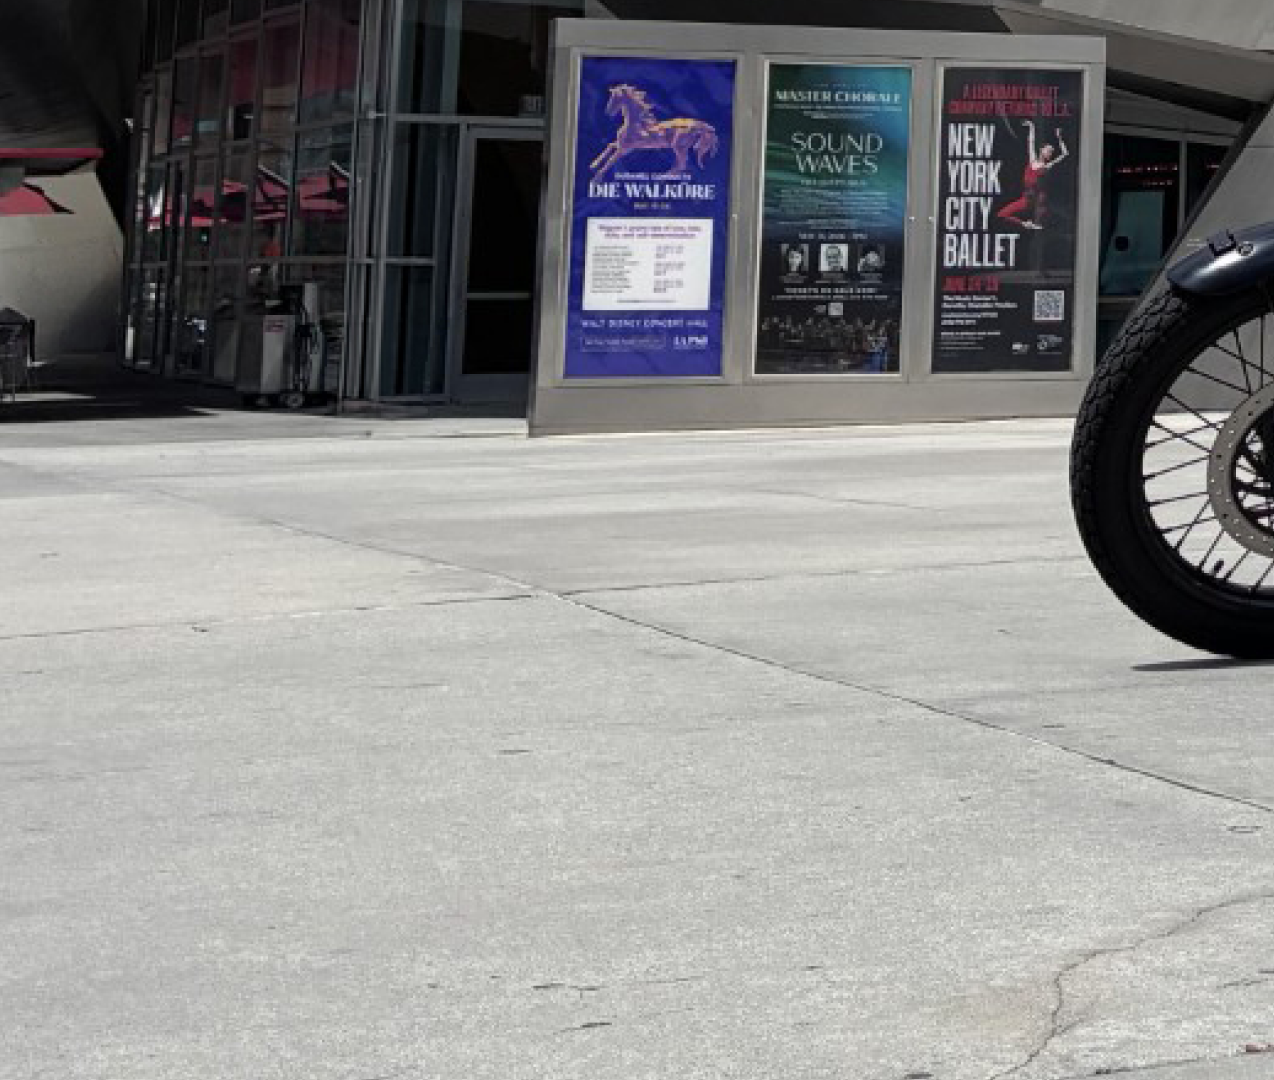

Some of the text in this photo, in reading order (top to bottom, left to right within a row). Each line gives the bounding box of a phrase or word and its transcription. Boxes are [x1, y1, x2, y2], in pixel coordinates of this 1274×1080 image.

[775, 90, 901, 103] MASTER CHORALE
[791, 131, 883, 154] SOUND
[947, 123, 996, 158] NEW
[795, 154, 879, 175] WAVES
[946, 159, 1003, 195] YORK
[588, 181, 620, 199] DIE
[945, 196, 994, 231] CITY
[943, 233, 1021, 268] BALLET
